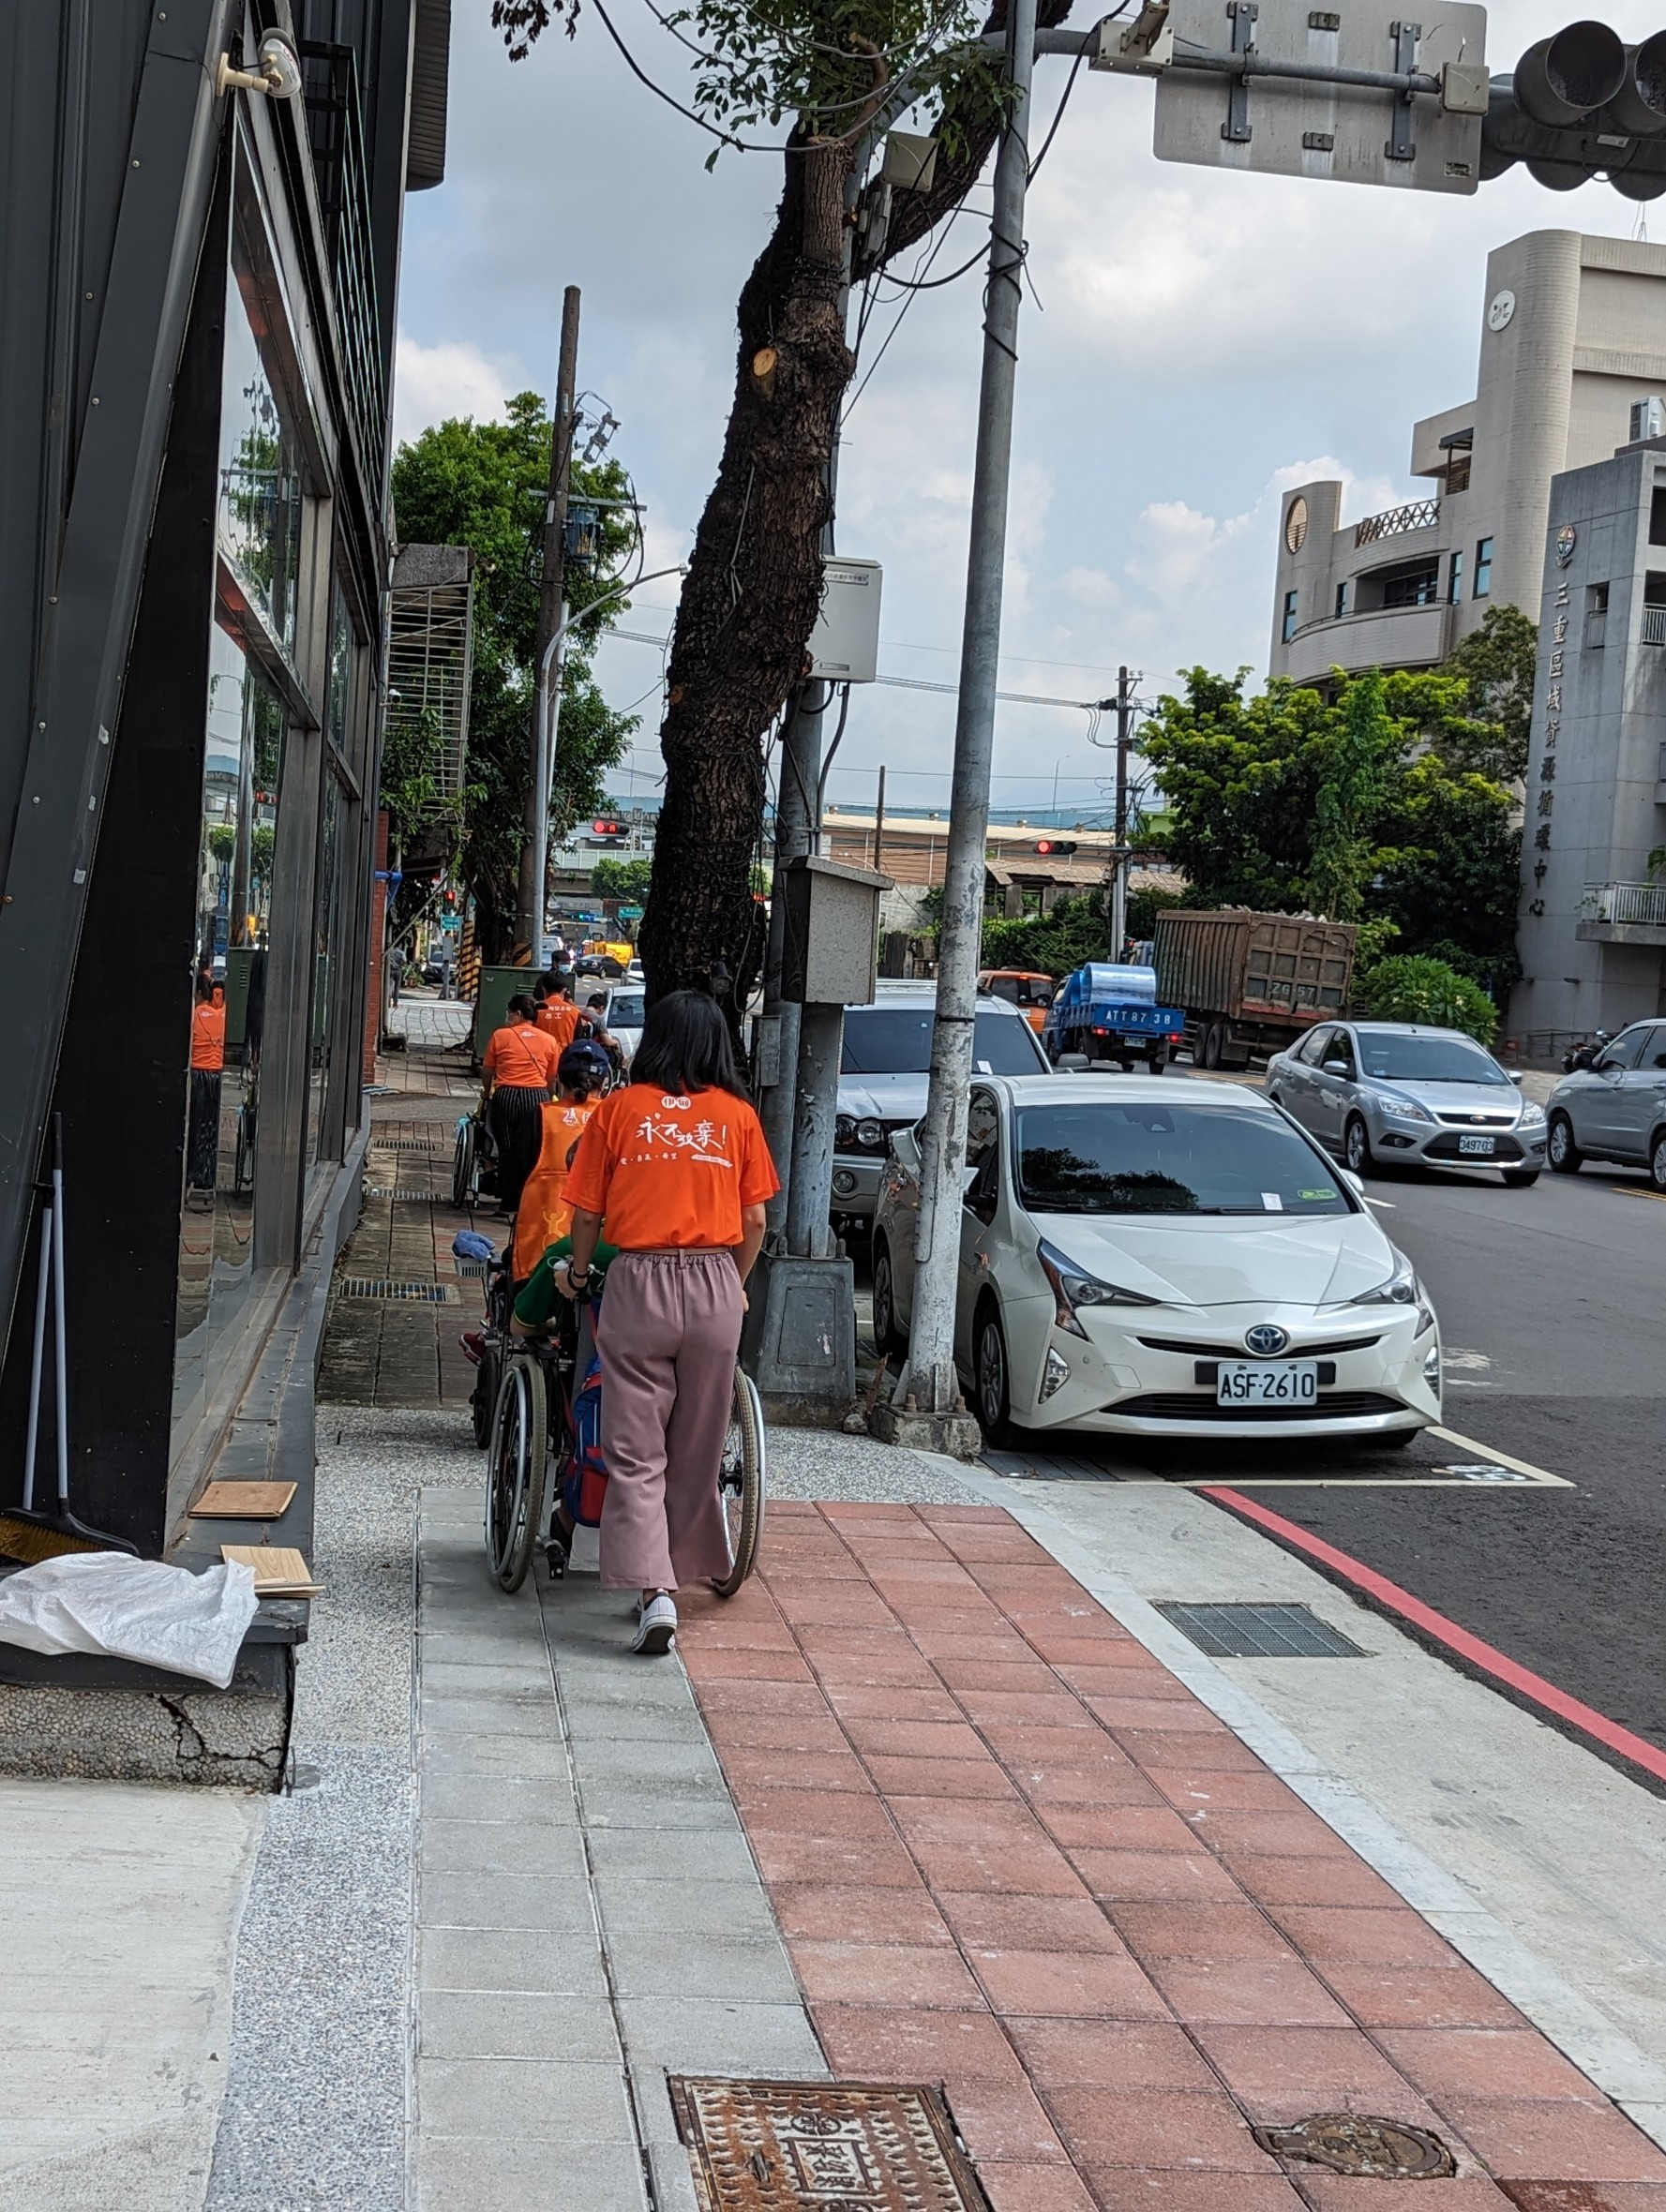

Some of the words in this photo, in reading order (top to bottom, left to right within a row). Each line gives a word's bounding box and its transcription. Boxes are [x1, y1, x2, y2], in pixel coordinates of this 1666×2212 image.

[1529, 582, 1569, 918] 三重區域資源循環中心
[1220, 1373, 1314, 1398] ASF-2610
